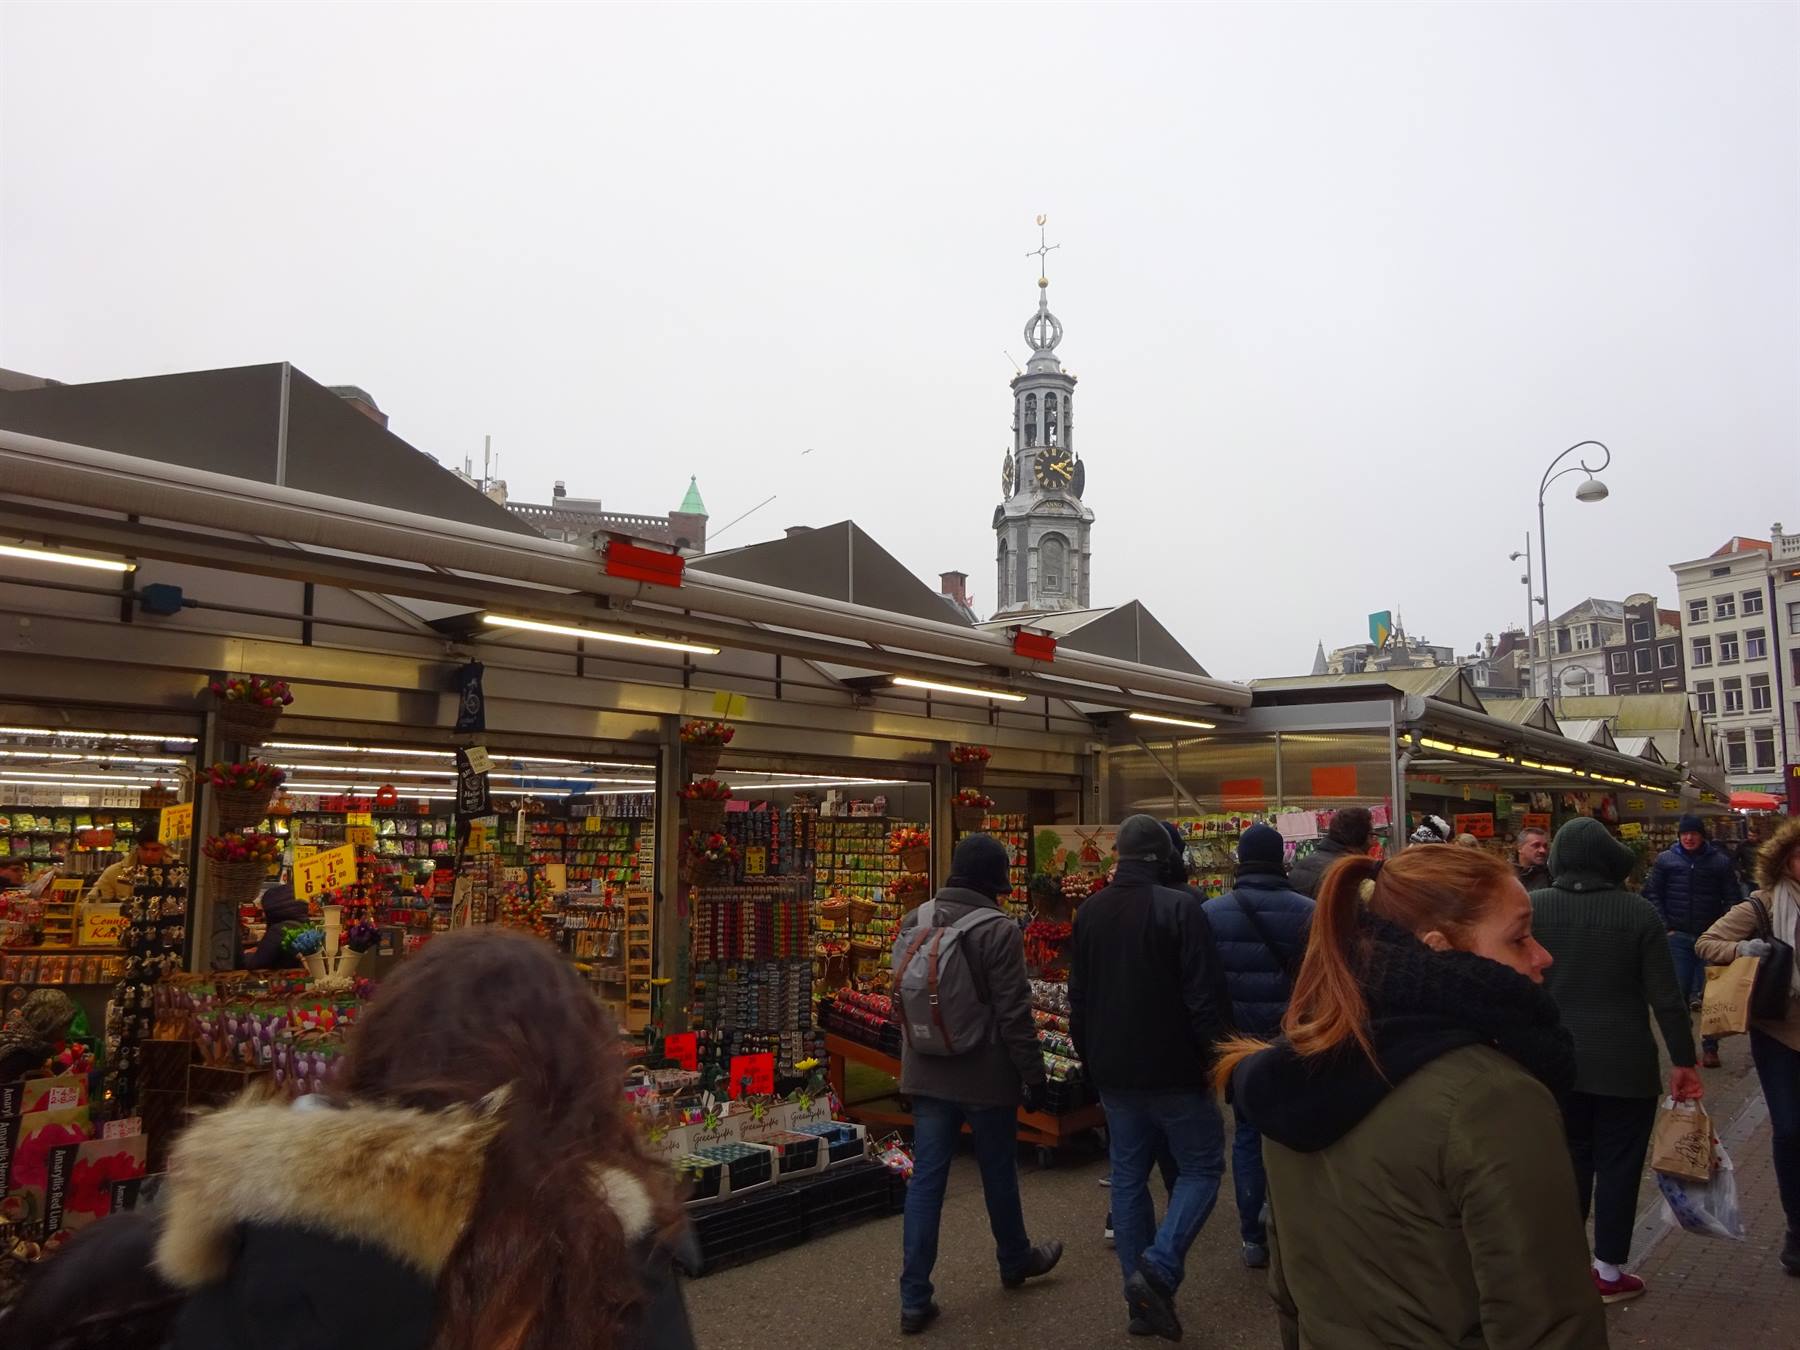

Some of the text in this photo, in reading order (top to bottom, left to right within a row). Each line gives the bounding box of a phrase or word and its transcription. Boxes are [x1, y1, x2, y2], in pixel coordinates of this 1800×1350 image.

[48, 1150, 66, 1231] Amaryllis Red Lion
